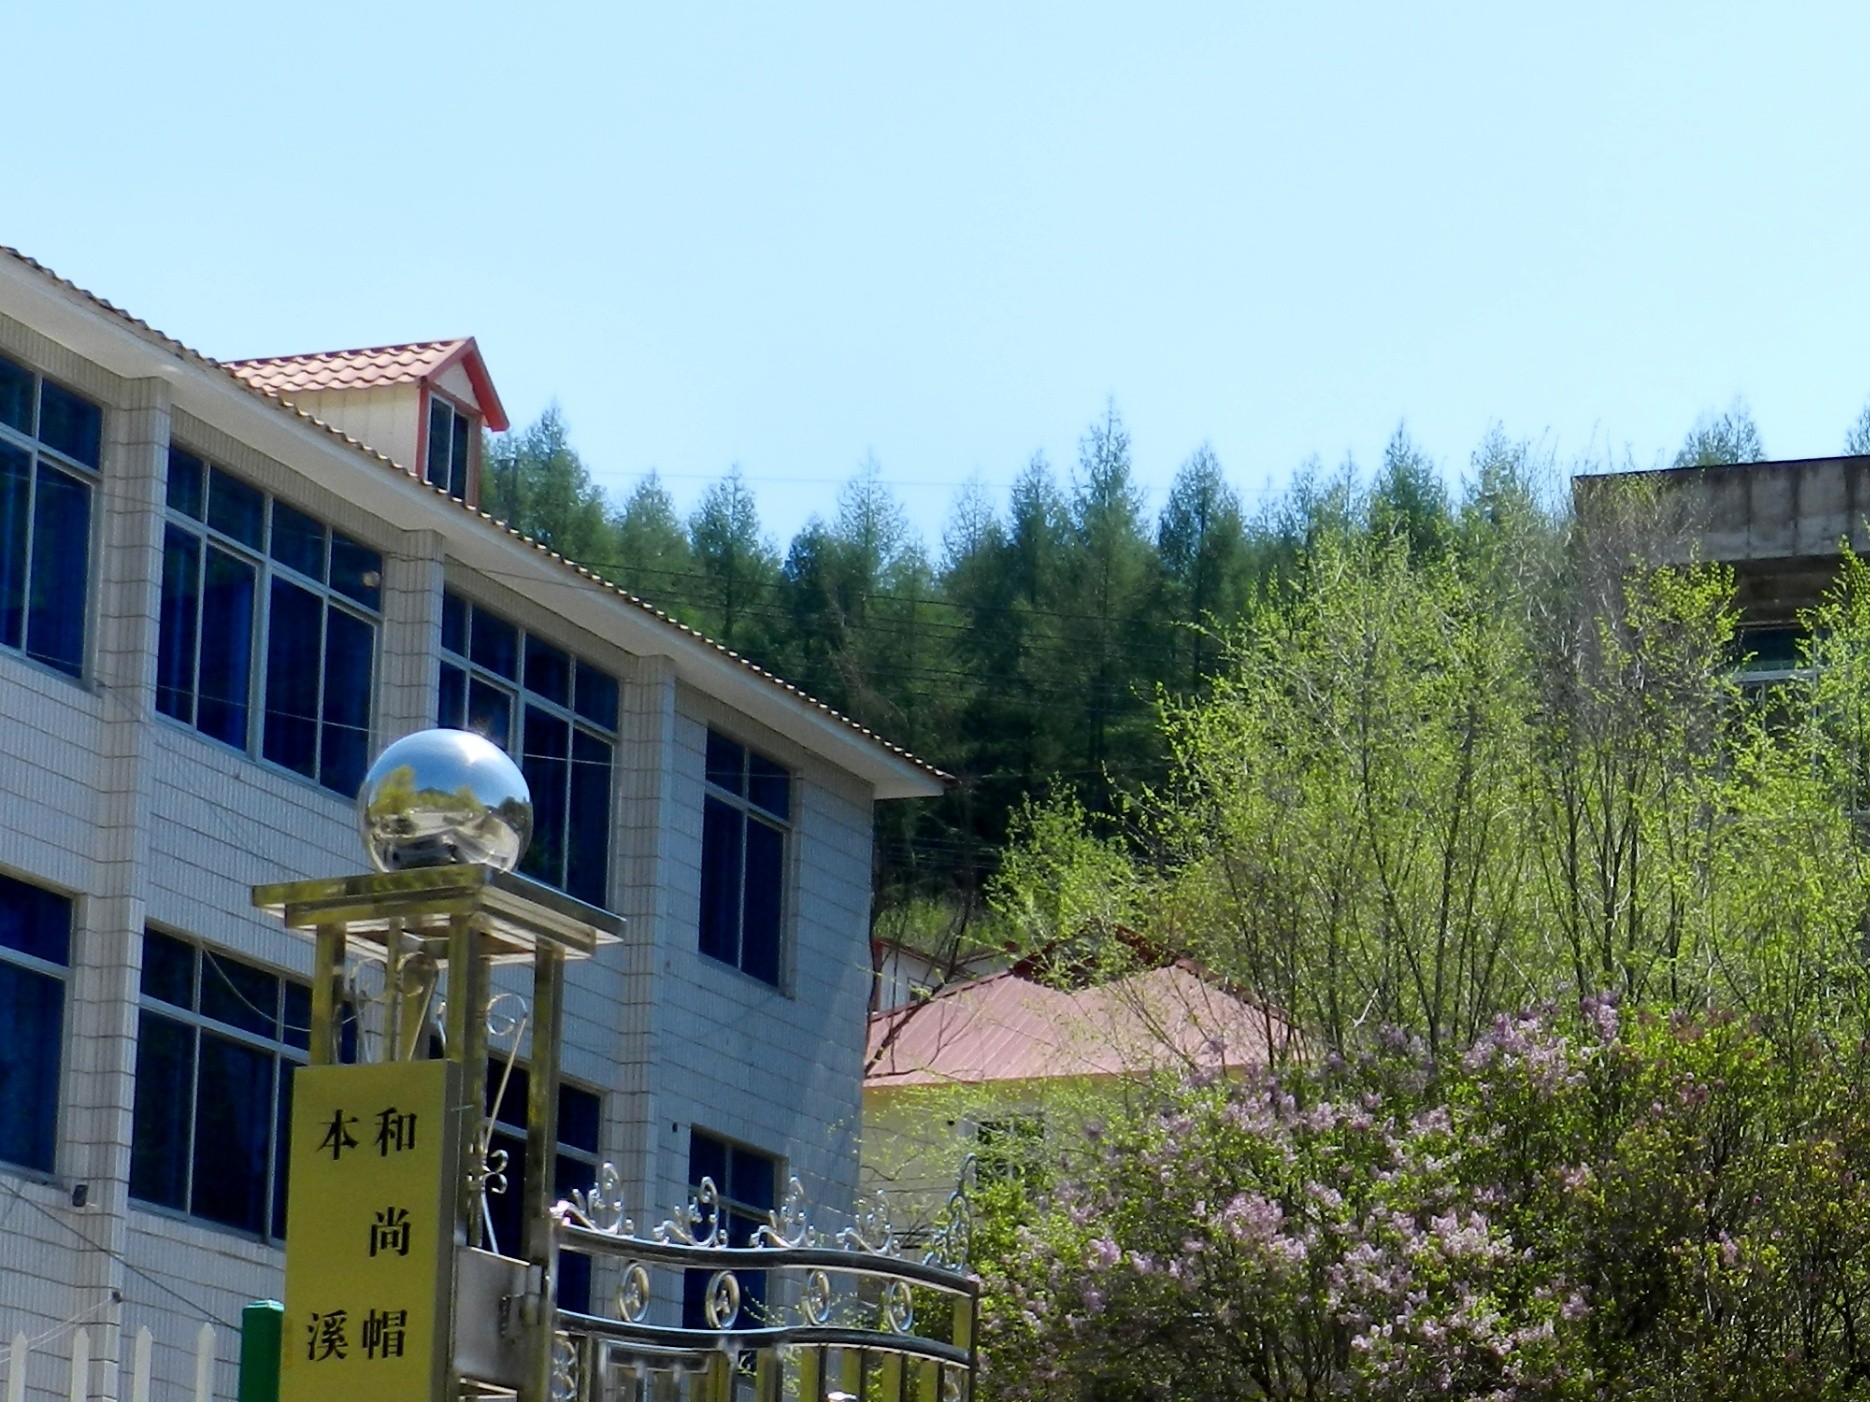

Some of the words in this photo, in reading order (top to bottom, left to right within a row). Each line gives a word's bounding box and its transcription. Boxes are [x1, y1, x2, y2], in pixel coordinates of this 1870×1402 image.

[306, 1107, 360, 1363] 本溪
[361, 1106, 417, 1359] 和尚帽
